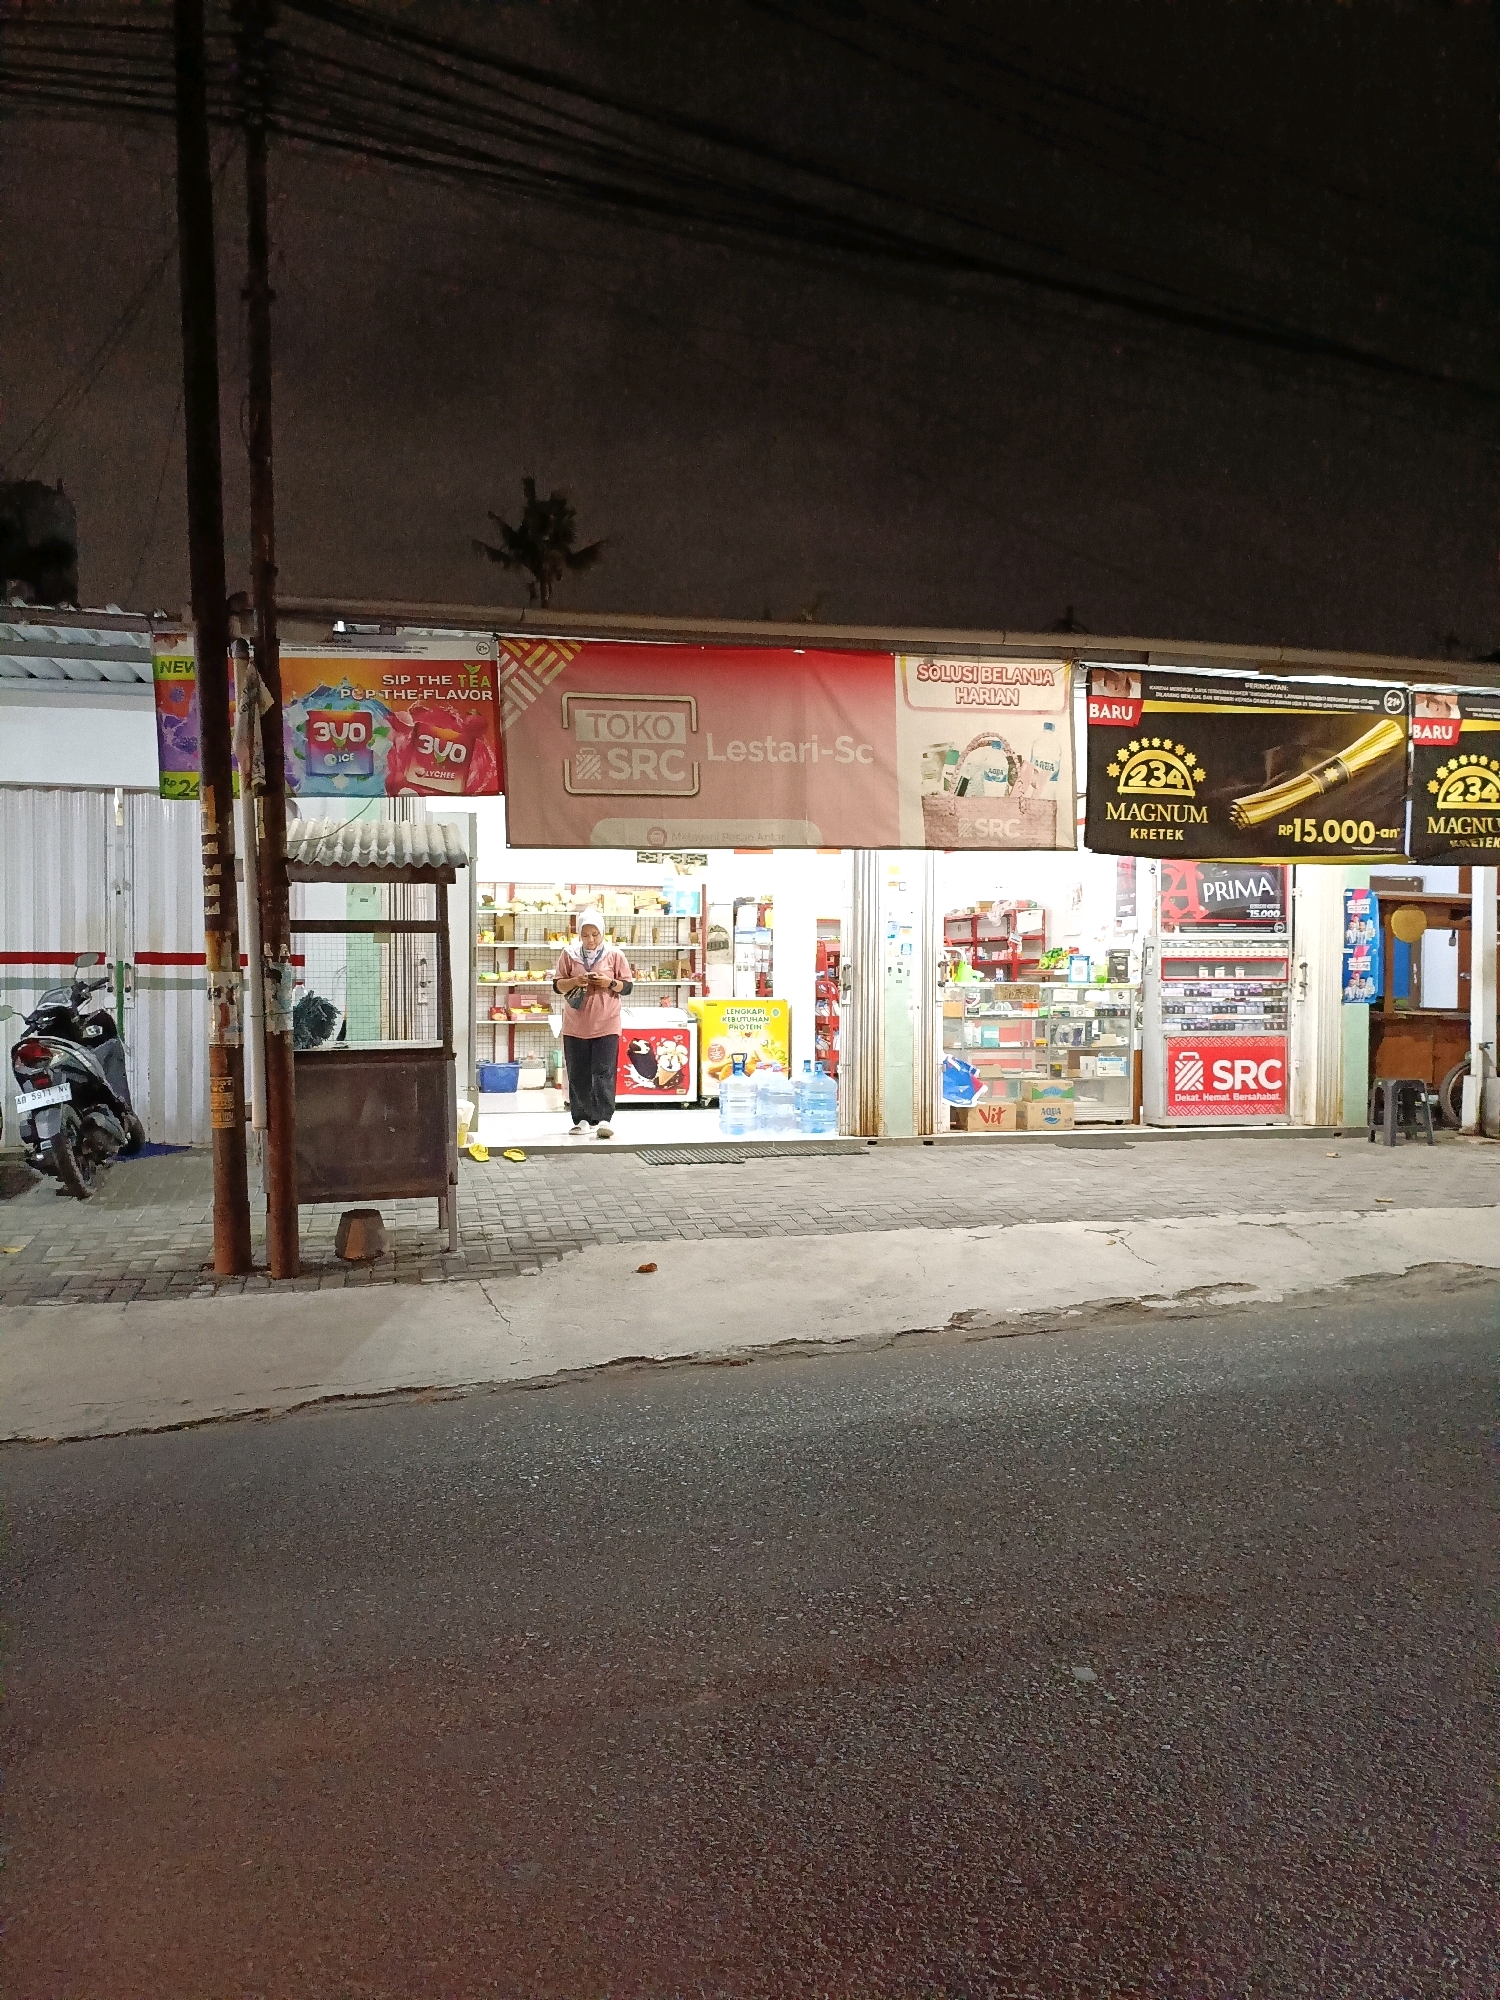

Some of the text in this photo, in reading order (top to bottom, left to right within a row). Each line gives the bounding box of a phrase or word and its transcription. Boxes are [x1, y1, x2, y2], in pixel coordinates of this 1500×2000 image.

[382, 674, 491, 688] SIP THE TEA
[917, 664, 1055, 686] SOLUSI BELANJA
[340, 689, 493, 701] POP THE FLAVOR
[954, 686, 1020, 706] HARIAN
[1089, 703, 1134, 721] BARU
[586, 712, 676, 742] TOKO
[1413, 724, 1453, 740] BARU
[338, 753, 355, 763] ICE
[706, 732, 875, 764] Lestari-Sc
[425, 771, 456, 779] LYCHEE
[607, 748, 686, 782] SRC
[1128, 761, 1184, 790] 234
[1446, 776, 1500, 803] 234
[1106, 801, 1209, 825] MAGNUM
[974, 818, 1021, 838] SRC
[1130, 828, 1184, 841] KRETEK
[1427, 816, 1500, 834] MAGNU
[1203, 877, 1275, 903] PRIMA
[1212, 1059, 1283, 1091] SRC
[1174, 1092, 1282, 1102] Dekat. Hemat. Bersahabat.
[978, 1105, 1007, 1125] Vit
[1041, 1107, 1062, 1116] AQUA
